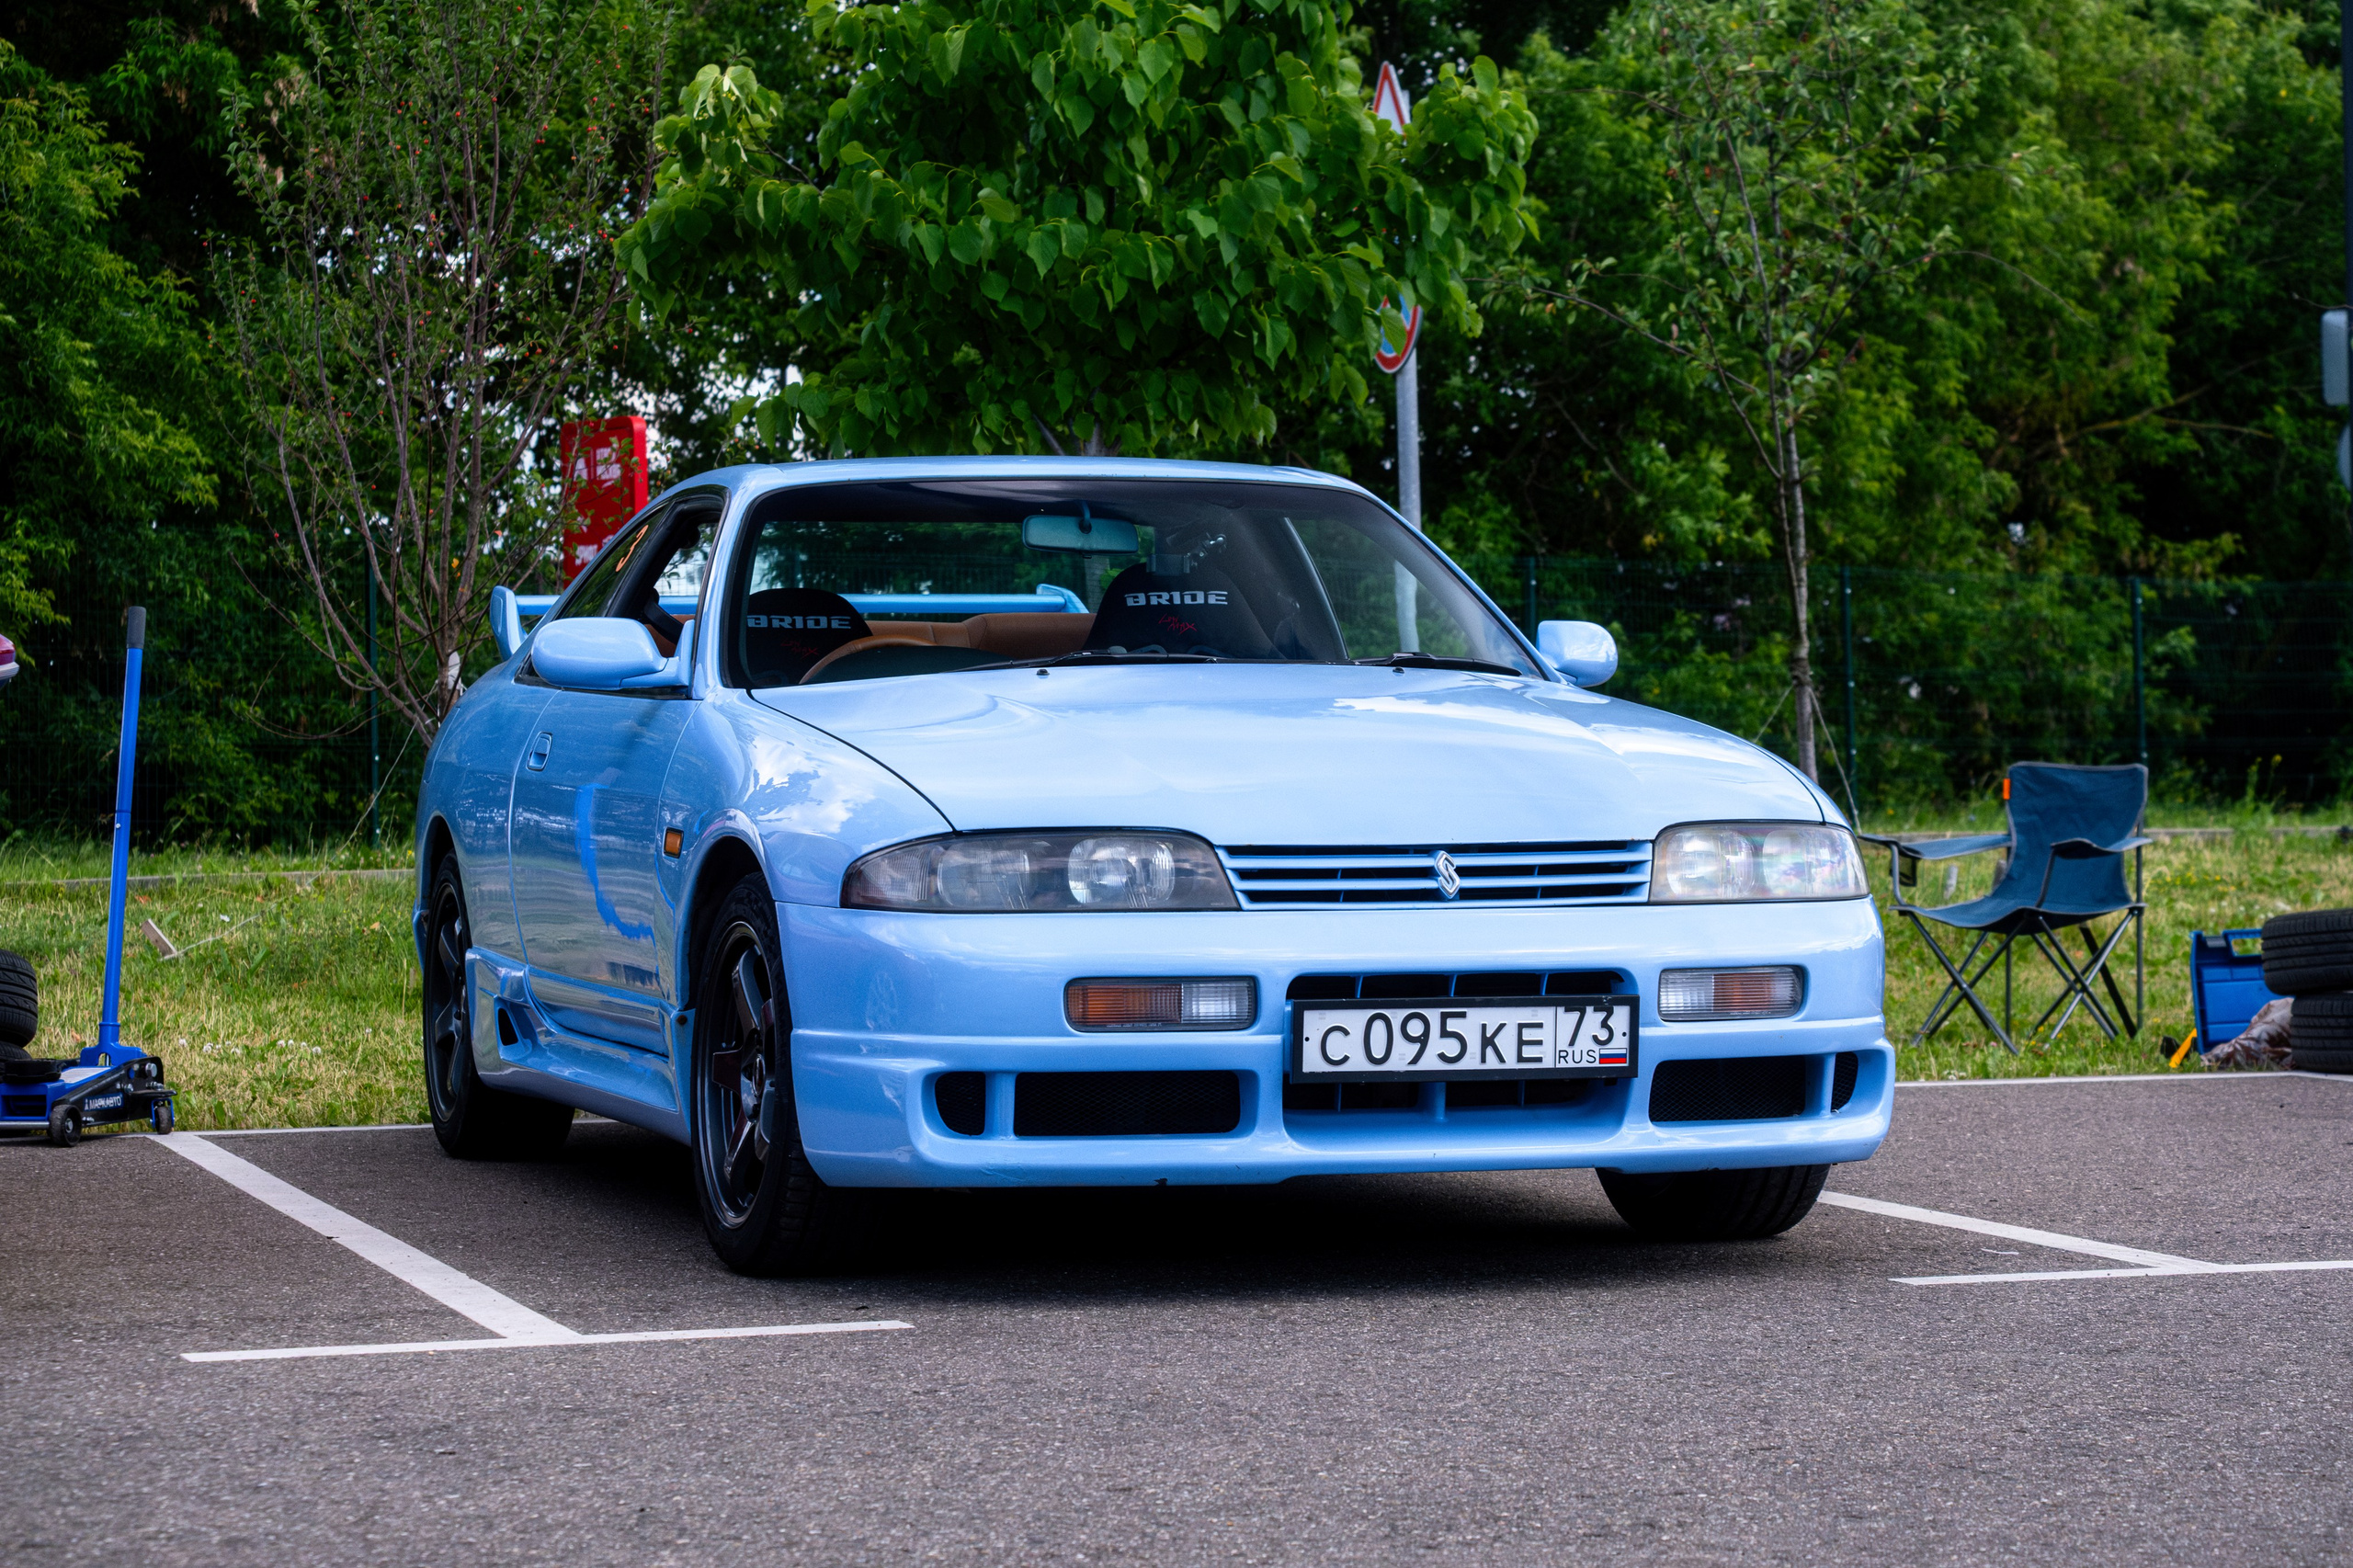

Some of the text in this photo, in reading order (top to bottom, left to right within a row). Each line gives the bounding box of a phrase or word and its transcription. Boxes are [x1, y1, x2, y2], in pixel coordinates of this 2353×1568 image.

[1124, 590, 1228, 607] BRIDE
[746, 615, 851, 629] BRIDE
[1563, 1005, 1615, 1047] 73
[1558, 1049, 1597, 1064] RUS
